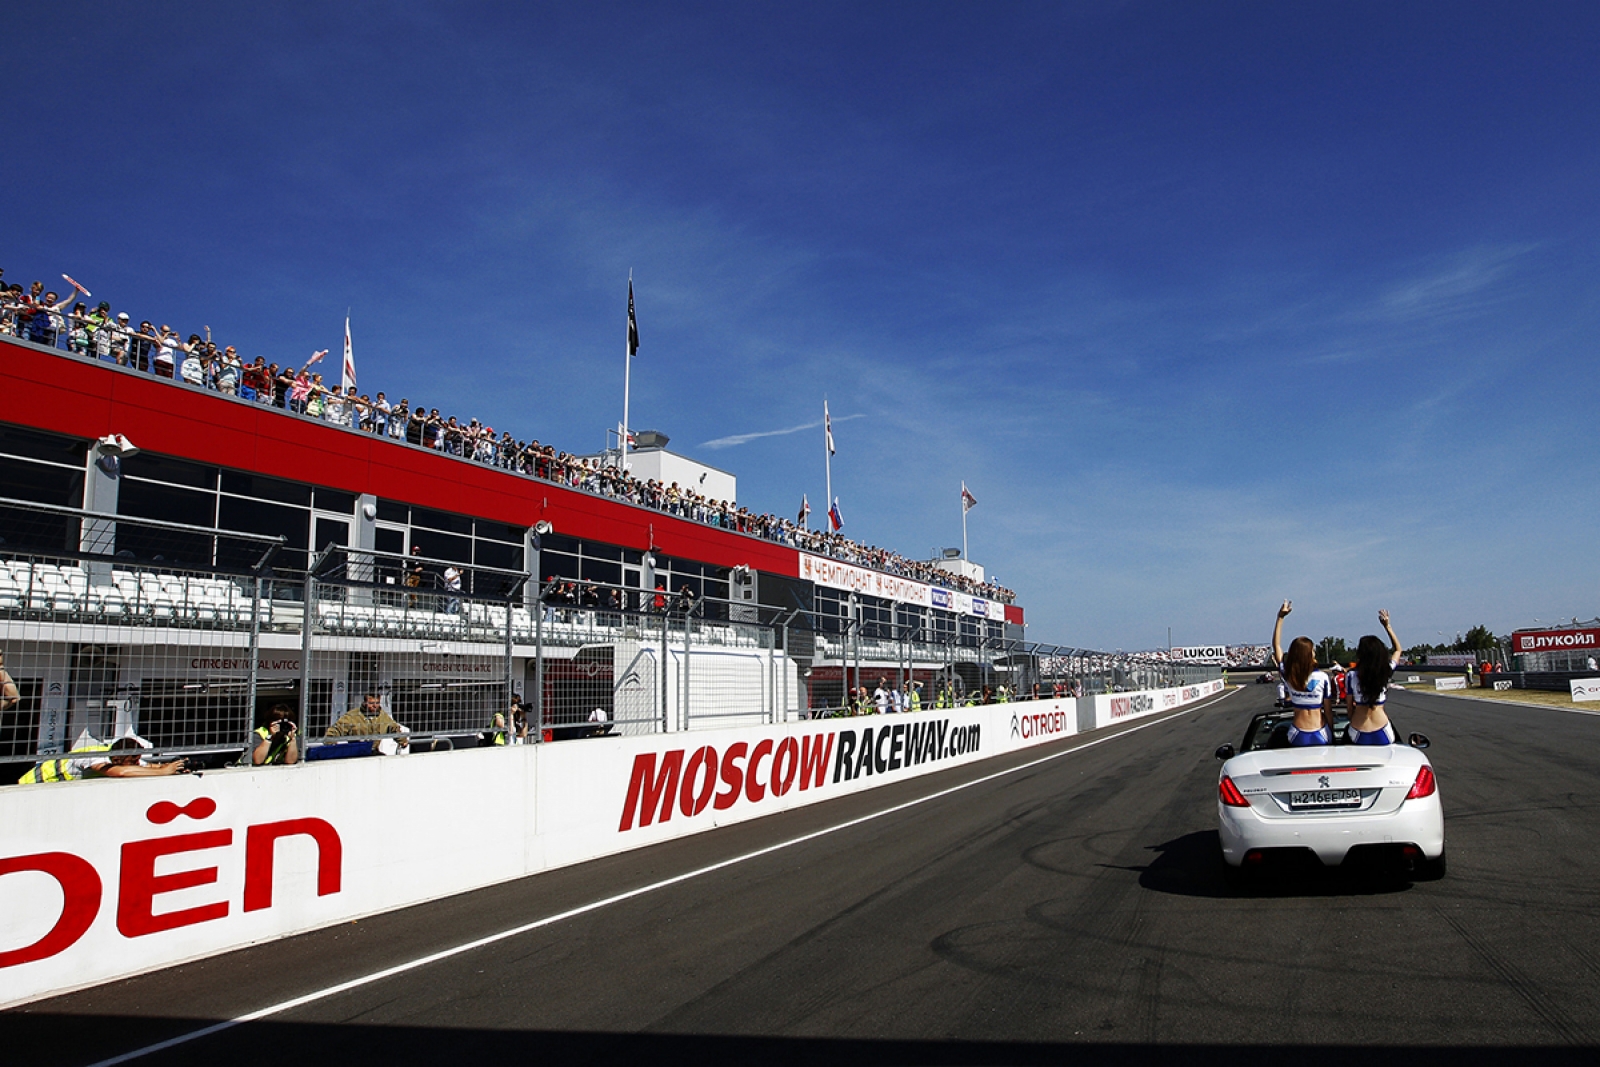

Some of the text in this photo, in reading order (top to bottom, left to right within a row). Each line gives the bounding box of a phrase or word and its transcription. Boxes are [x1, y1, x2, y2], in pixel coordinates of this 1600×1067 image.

[814, 560, 872, 590] ЧЕМПИОНАТ
[1536, 632, 1595, 647] ЛУКОЙЛ
[1184, 648, 1224, 658] LUKOIL
[272, 660, 299, 670] WTCC
